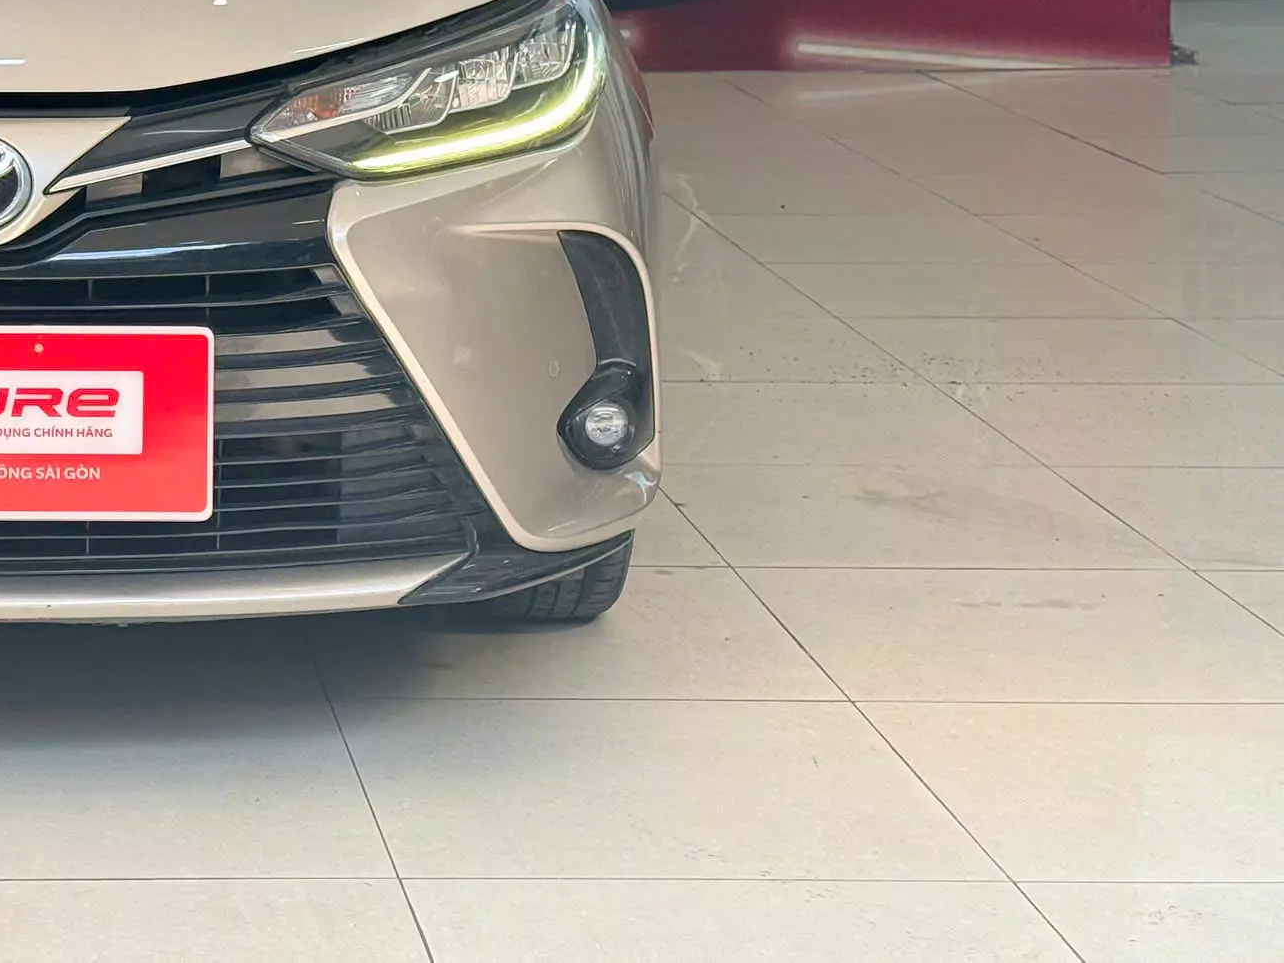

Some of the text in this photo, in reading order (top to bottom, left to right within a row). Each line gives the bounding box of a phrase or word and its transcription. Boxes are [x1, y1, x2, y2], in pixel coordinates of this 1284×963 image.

[34, 425, 73, 438] CHÍNH
[35, 464, 60, 480] SÀI
[63, 464, 101, 480] GÒN
